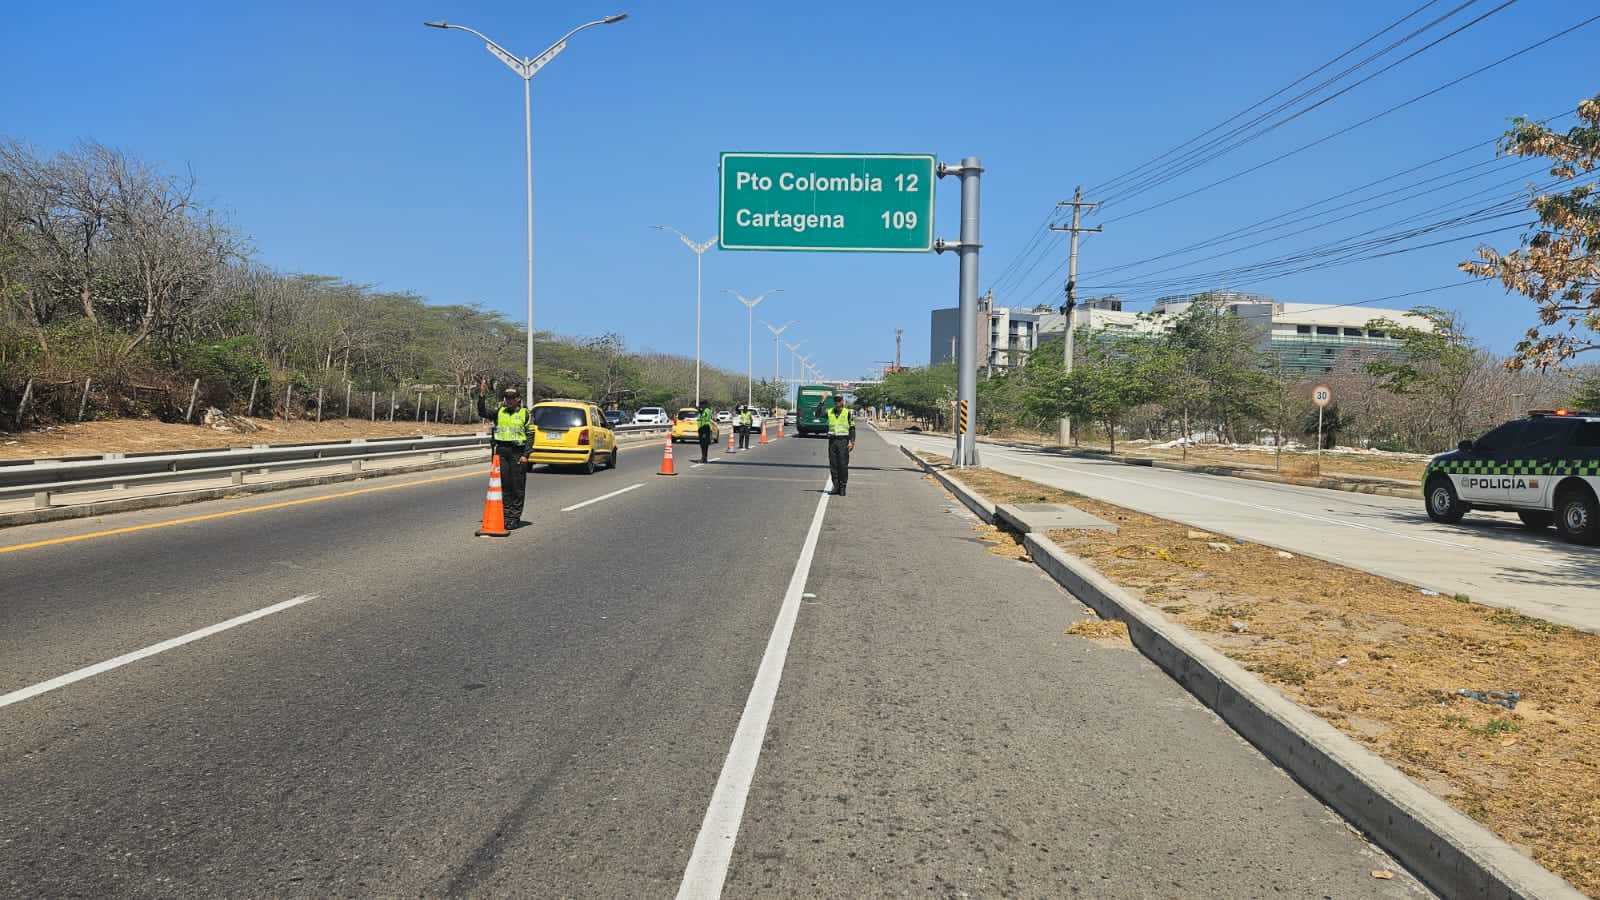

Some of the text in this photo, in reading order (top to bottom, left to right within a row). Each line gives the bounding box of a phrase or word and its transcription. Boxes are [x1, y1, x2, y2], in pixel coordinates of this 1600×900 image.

[736, 171, 919, 192] Pto Colombia 12
[736, 208, 917, 232] Cartagena 109
[1317, 391, 1327, 400] 30
[1470, 478, 1527, 489] POLICIA
